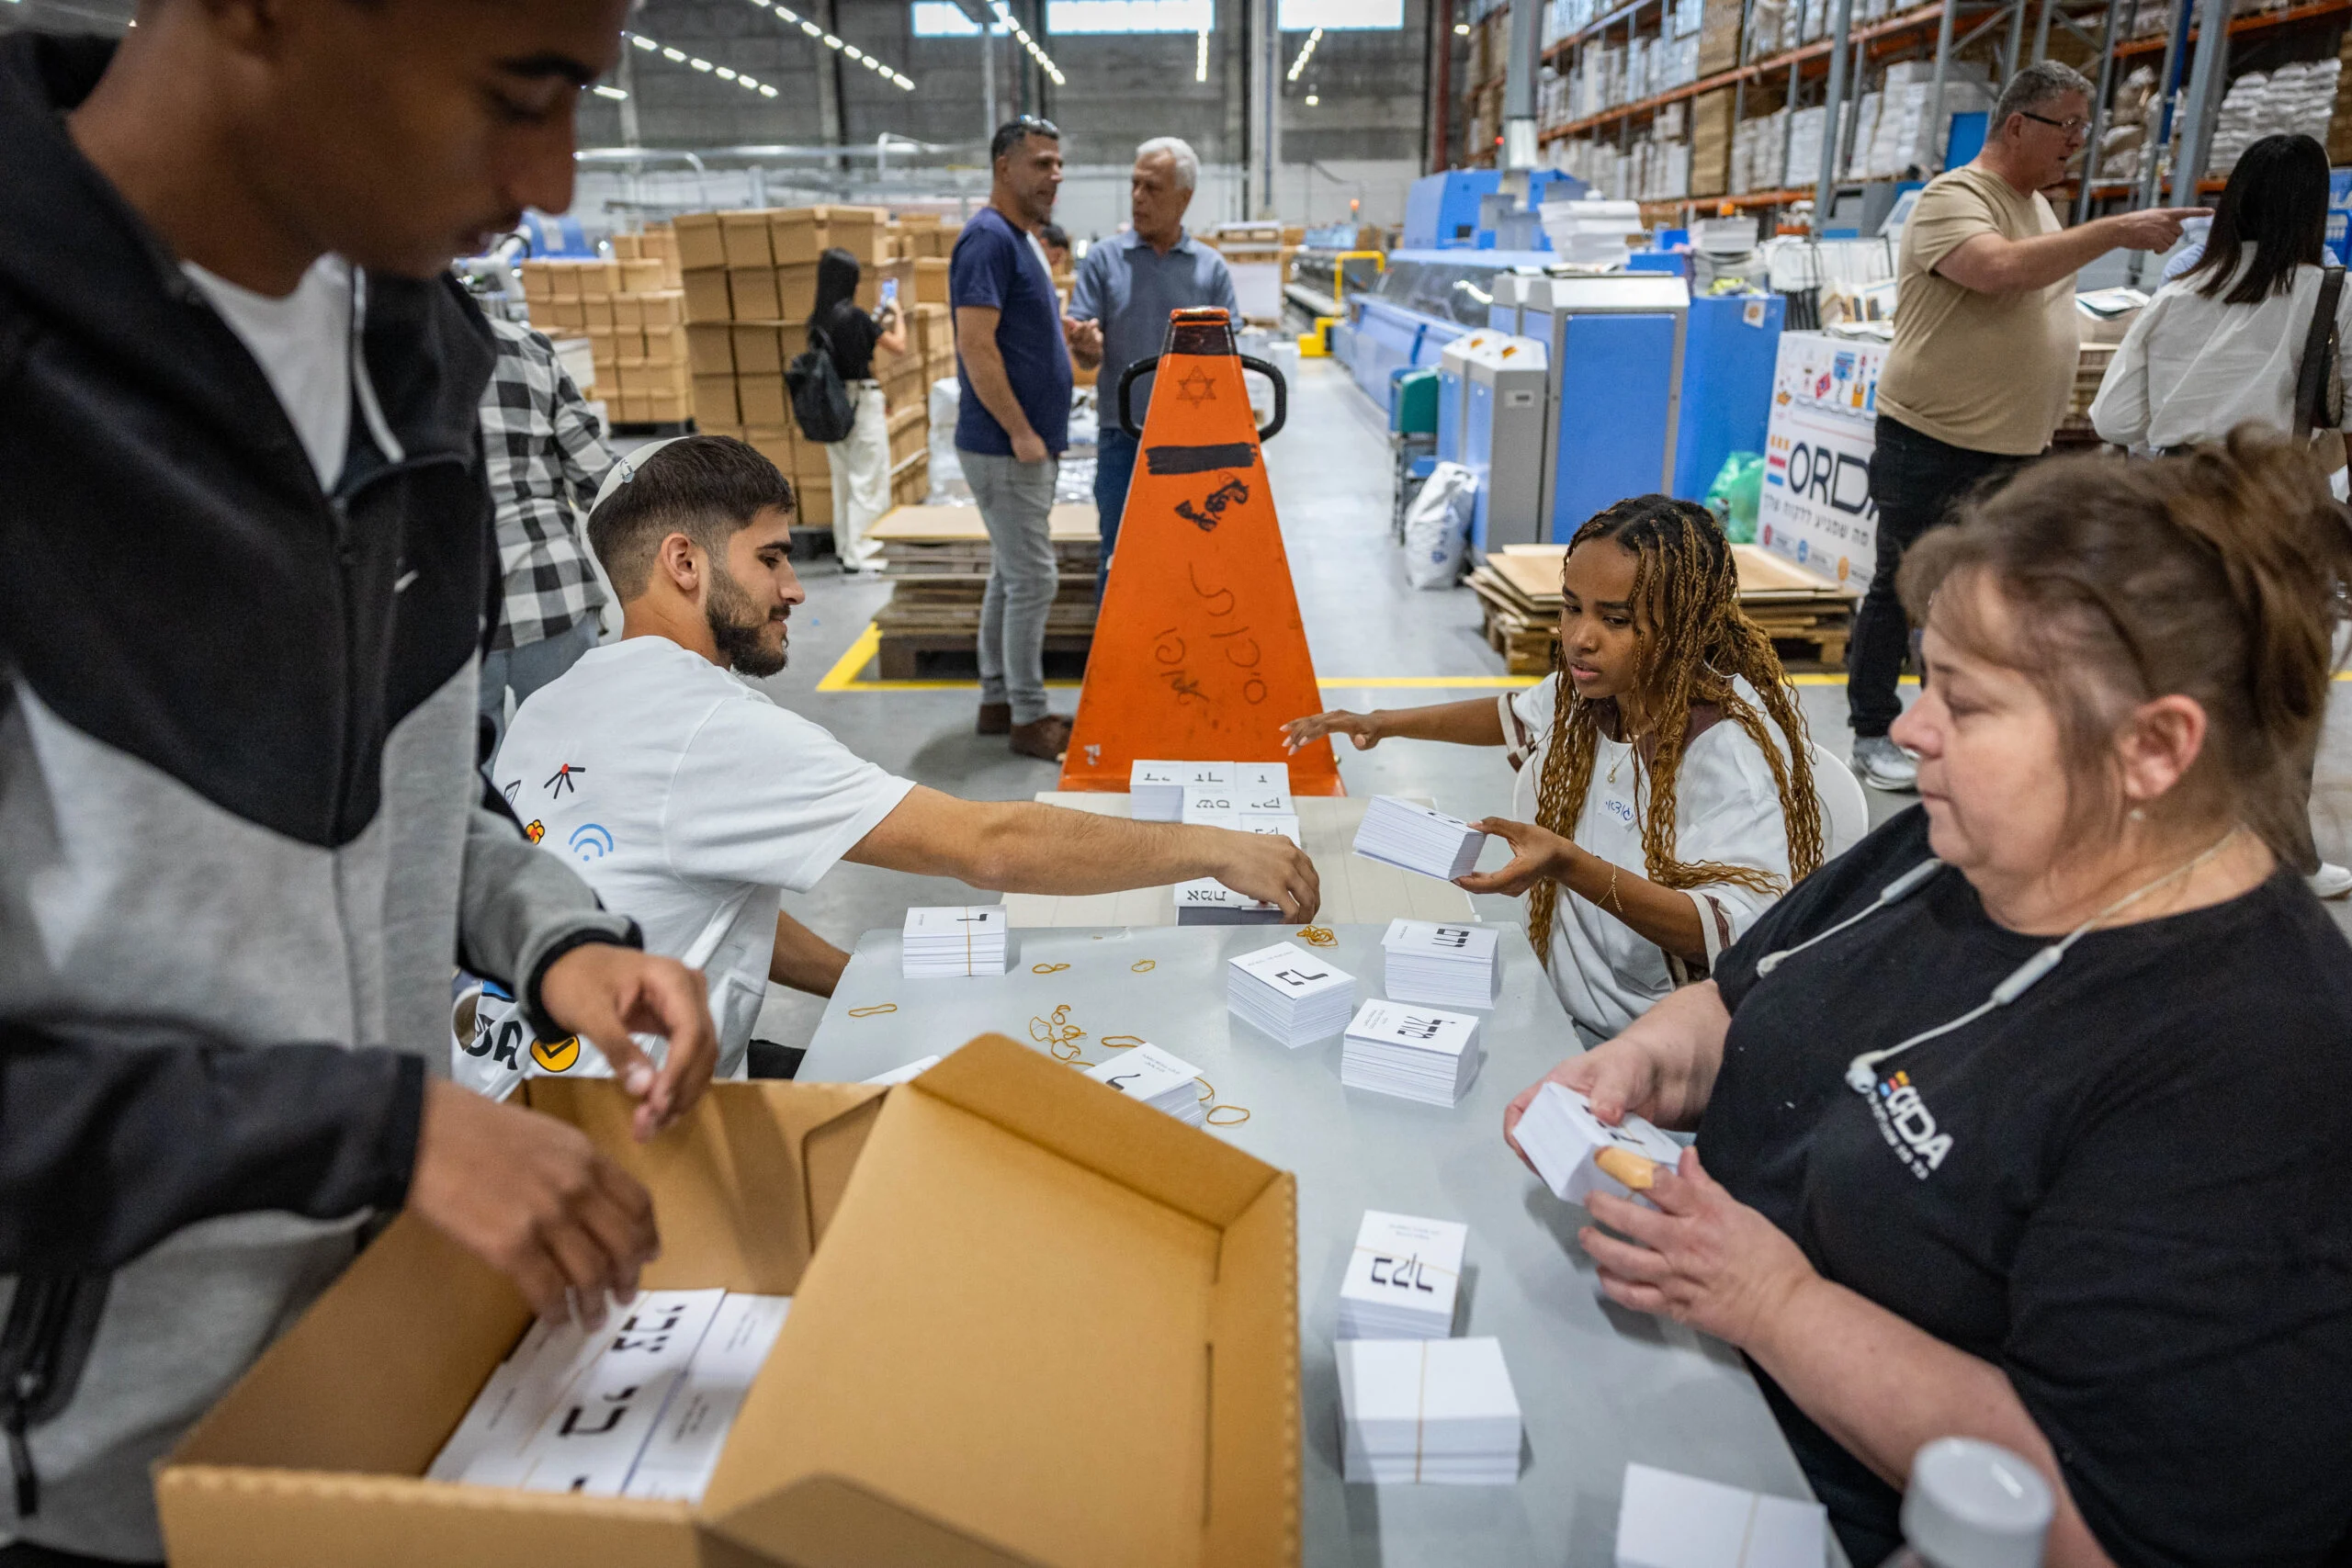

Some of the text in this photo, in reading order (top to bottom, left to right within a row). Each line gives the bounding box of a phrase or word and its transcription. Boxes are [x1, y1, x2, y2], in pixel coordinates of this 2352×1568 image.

[1789, 441, 1880, 522] ORD
[1195, 799, 1231, 809] שס
[1251, 796, 1281, 809] יק
[1187, 889, 1227, 901] אמת
[1396, 1015, 1456, 1039] מחל
